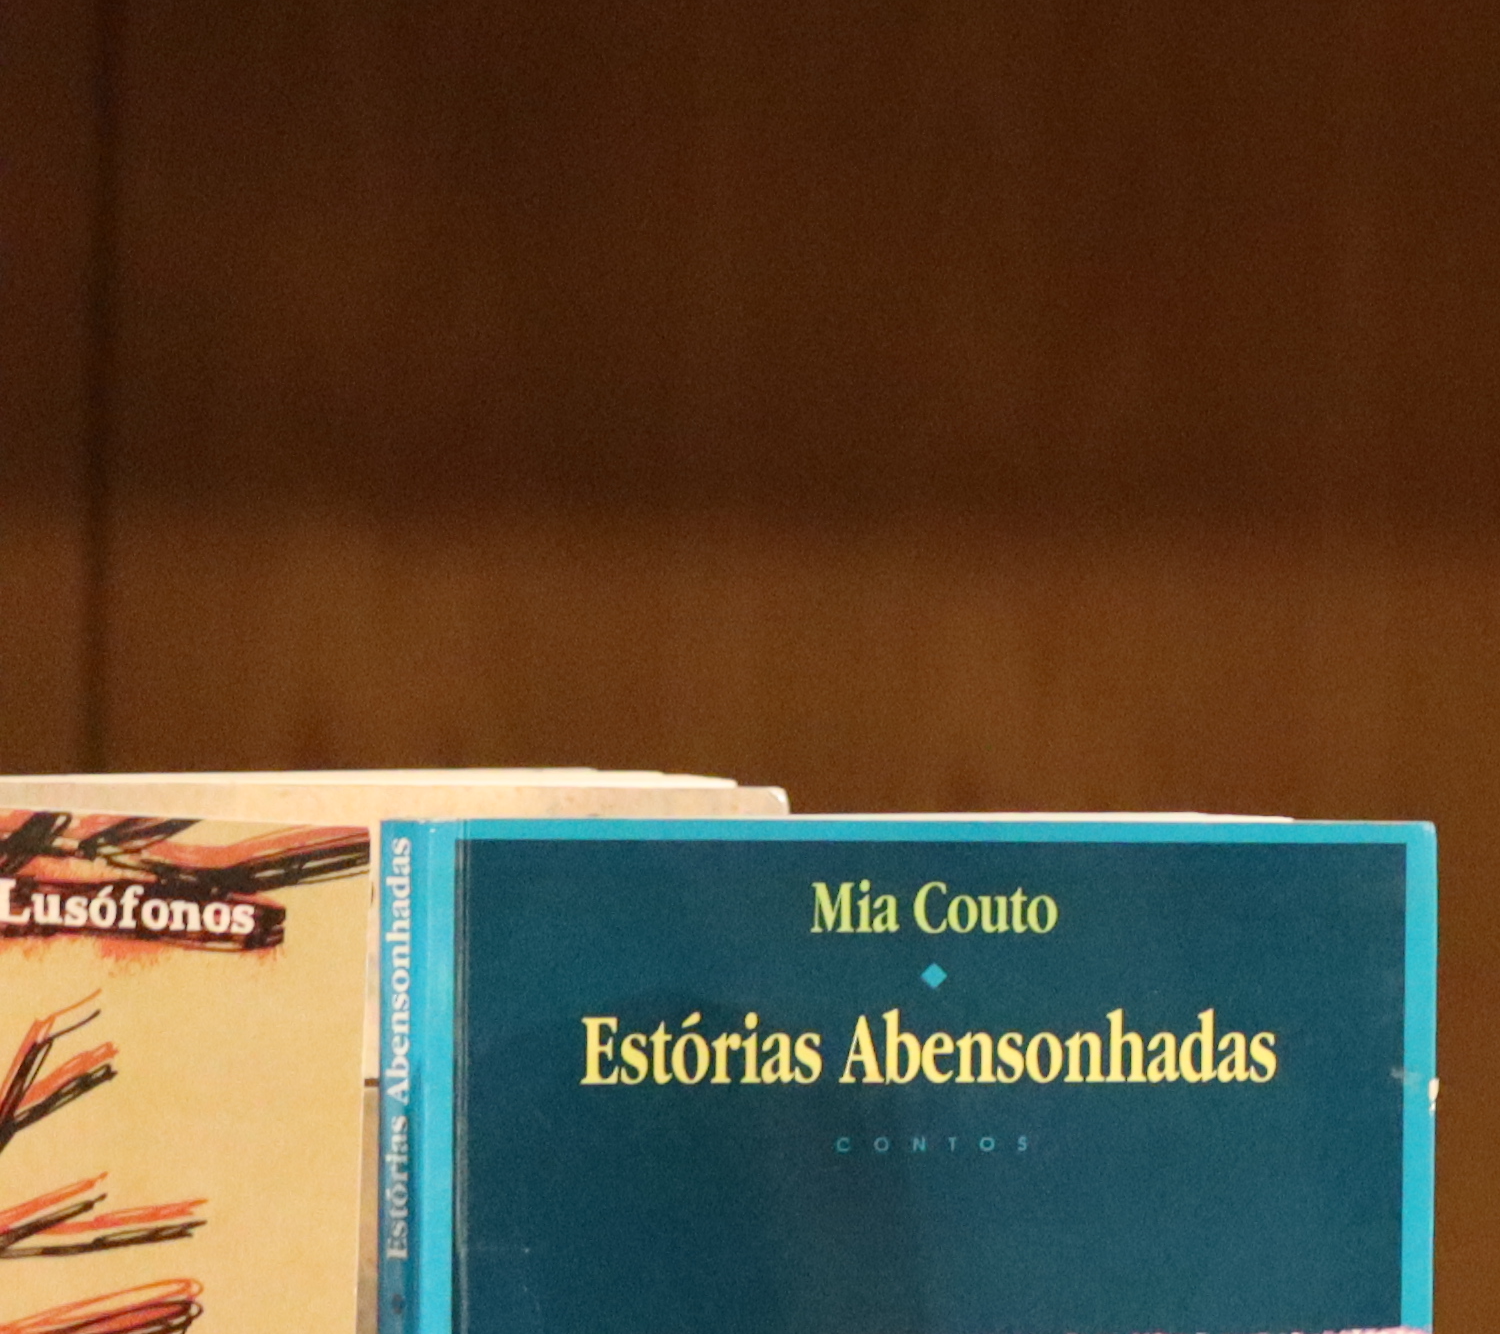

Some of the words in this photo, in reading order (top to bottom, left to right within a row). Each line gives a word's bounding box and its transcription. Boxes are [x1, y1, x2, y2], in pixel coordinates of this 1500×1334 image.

[0, 877, 256, 935] Lusófonos
[810, 879, 899, 934] Mia
[913, 881, 1059, 935] Couto
[385, 836, 412, 1106] Abensonhadas
[580, 1012, 822, 1086] Estórias
[839, 1008, 1278, 1086] Abensonhadas
[836, 1134, 1030, 1154] CONTOS
[385, 1115, 410, 1260] Estórias
